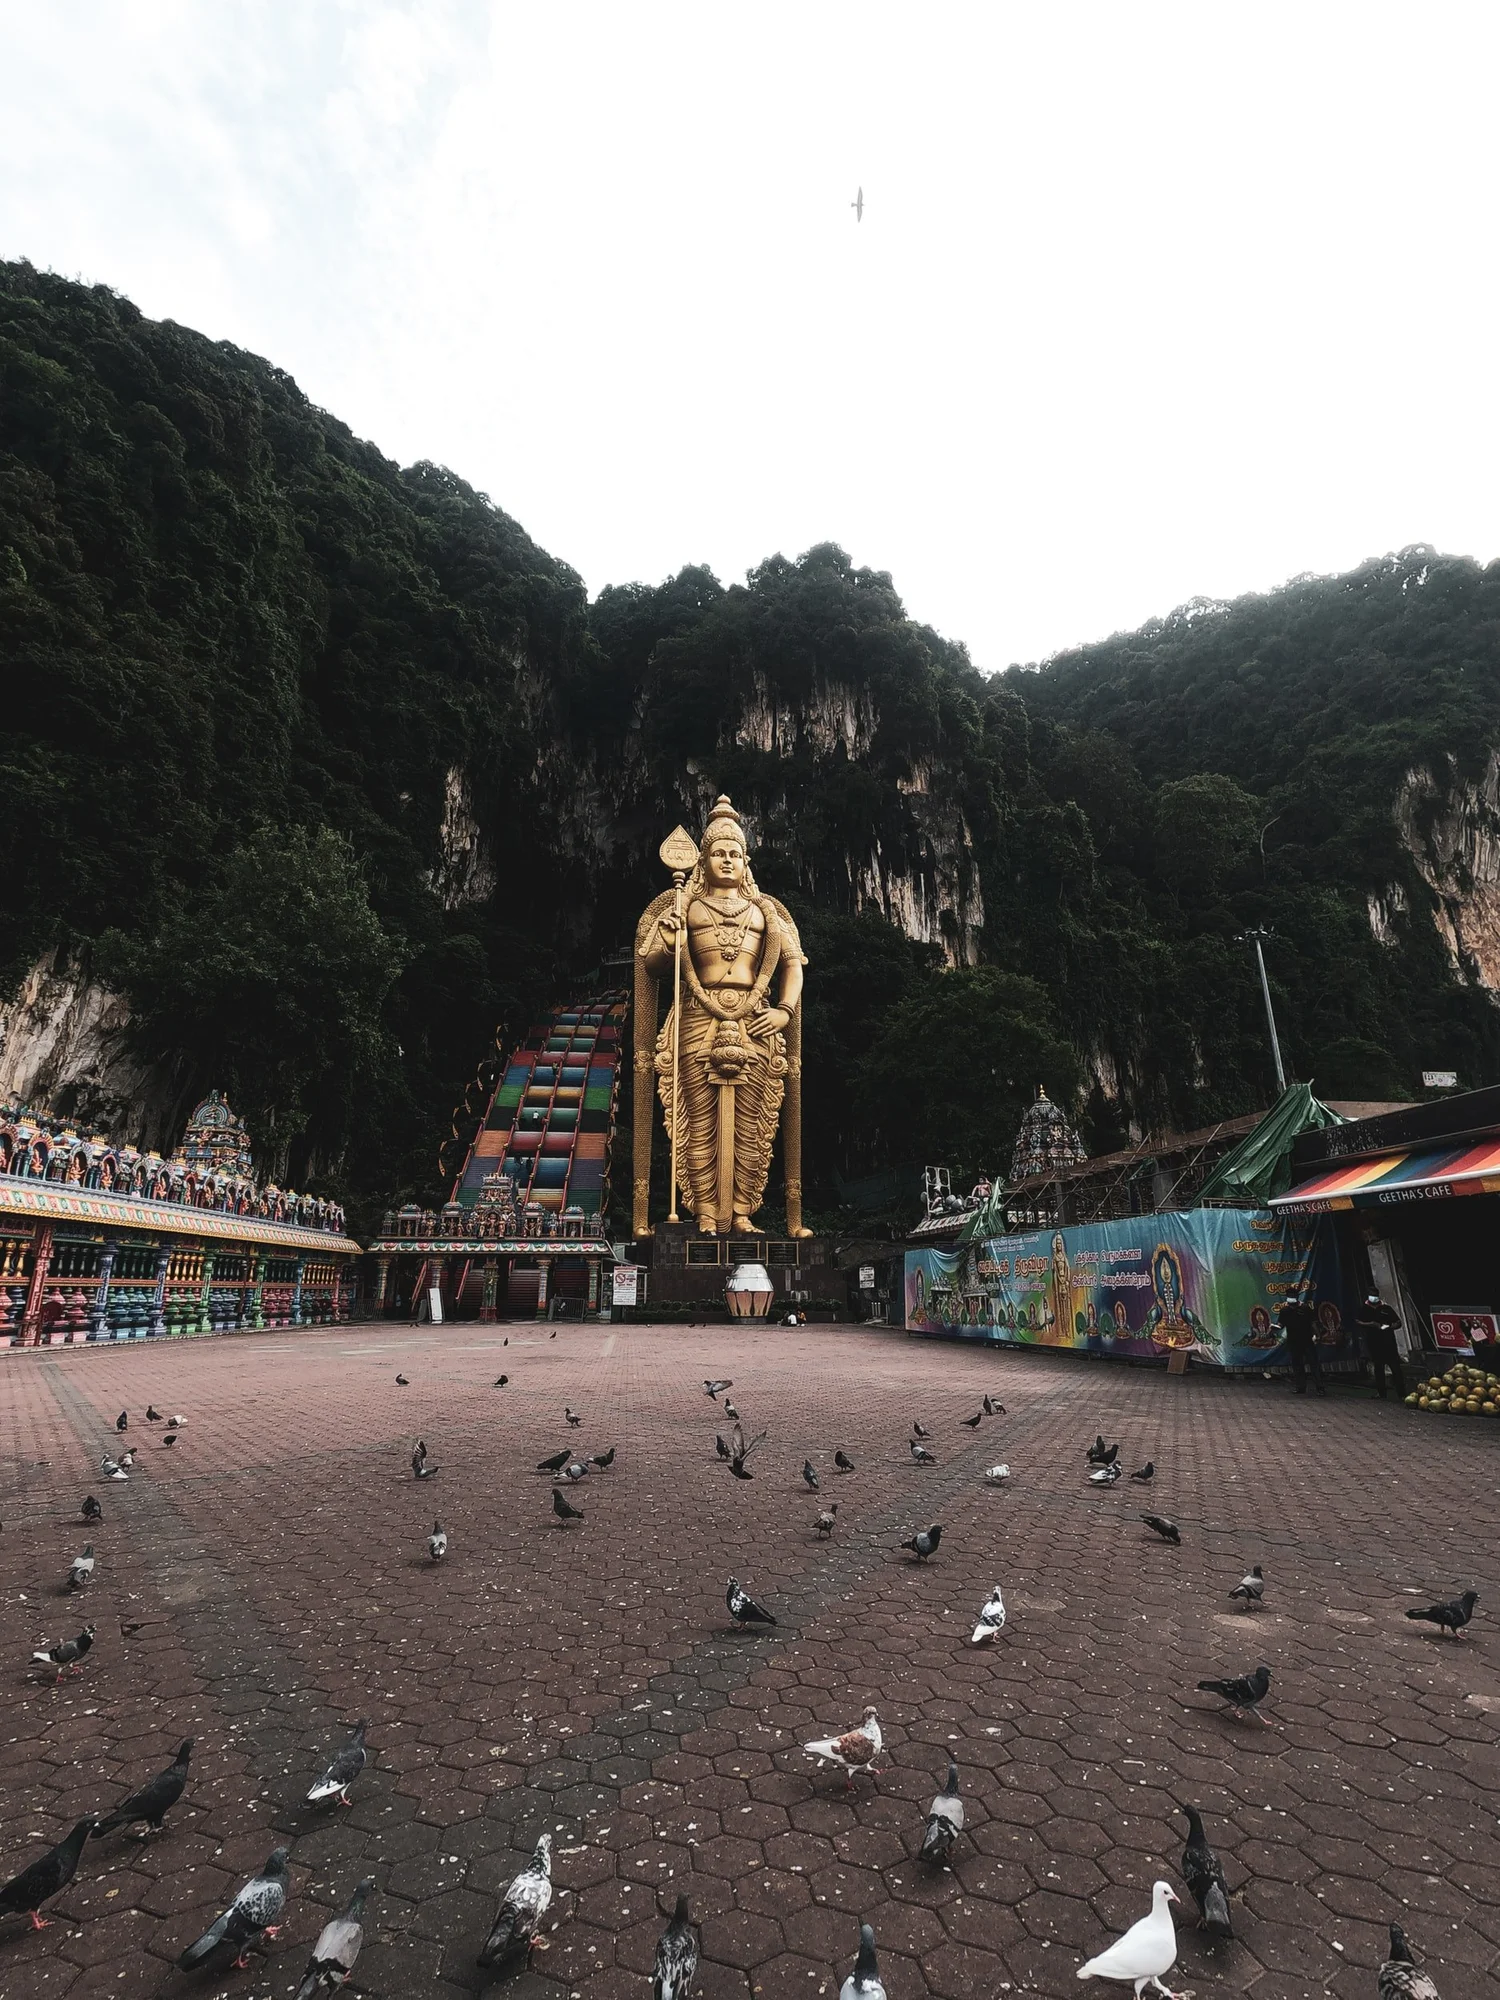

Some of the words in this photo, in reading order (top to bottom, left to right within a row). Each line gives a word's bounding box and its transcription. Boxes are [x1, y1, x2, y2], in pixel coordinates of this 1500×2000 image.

[1379, 1188, 1424, 1203] GEETHA'S
[1425, 1184, 1452, 1198] CAFE
[1276, 1202, 1311, 1216] GEETHA'S
[1312, 1200, 1332, 1213] CAFE
